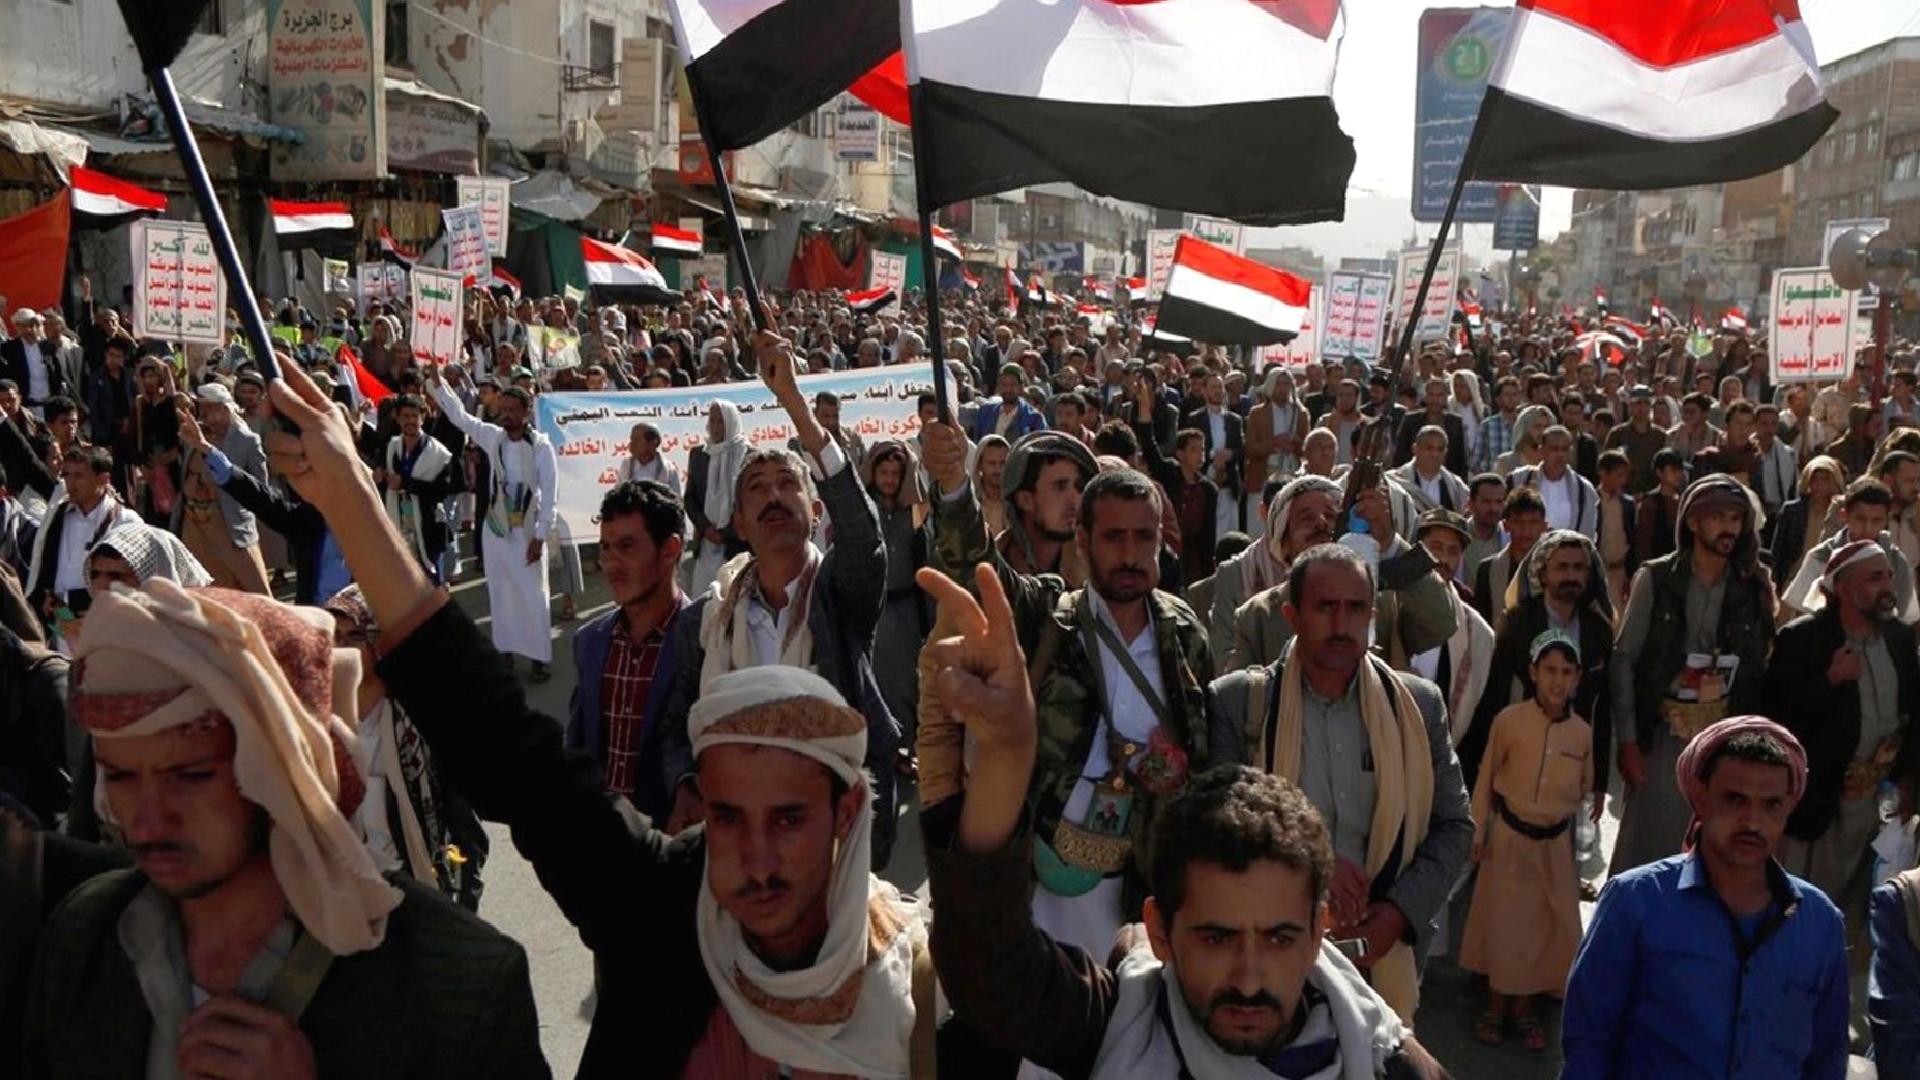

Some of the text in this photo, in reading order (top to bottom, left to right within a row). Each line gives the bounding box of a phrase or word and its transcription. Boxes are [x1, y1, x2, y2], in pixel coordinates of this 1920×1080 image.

[283, 9, 353, 34] برج الجزيرة
[865, 382, 893, 402] أبناء
[898, 383, 934, 400] حتفل
[556, 407, 609, 425] اليمني
[614, 406, 661, 417] الشعب
[661, 435, 678, 451] من
